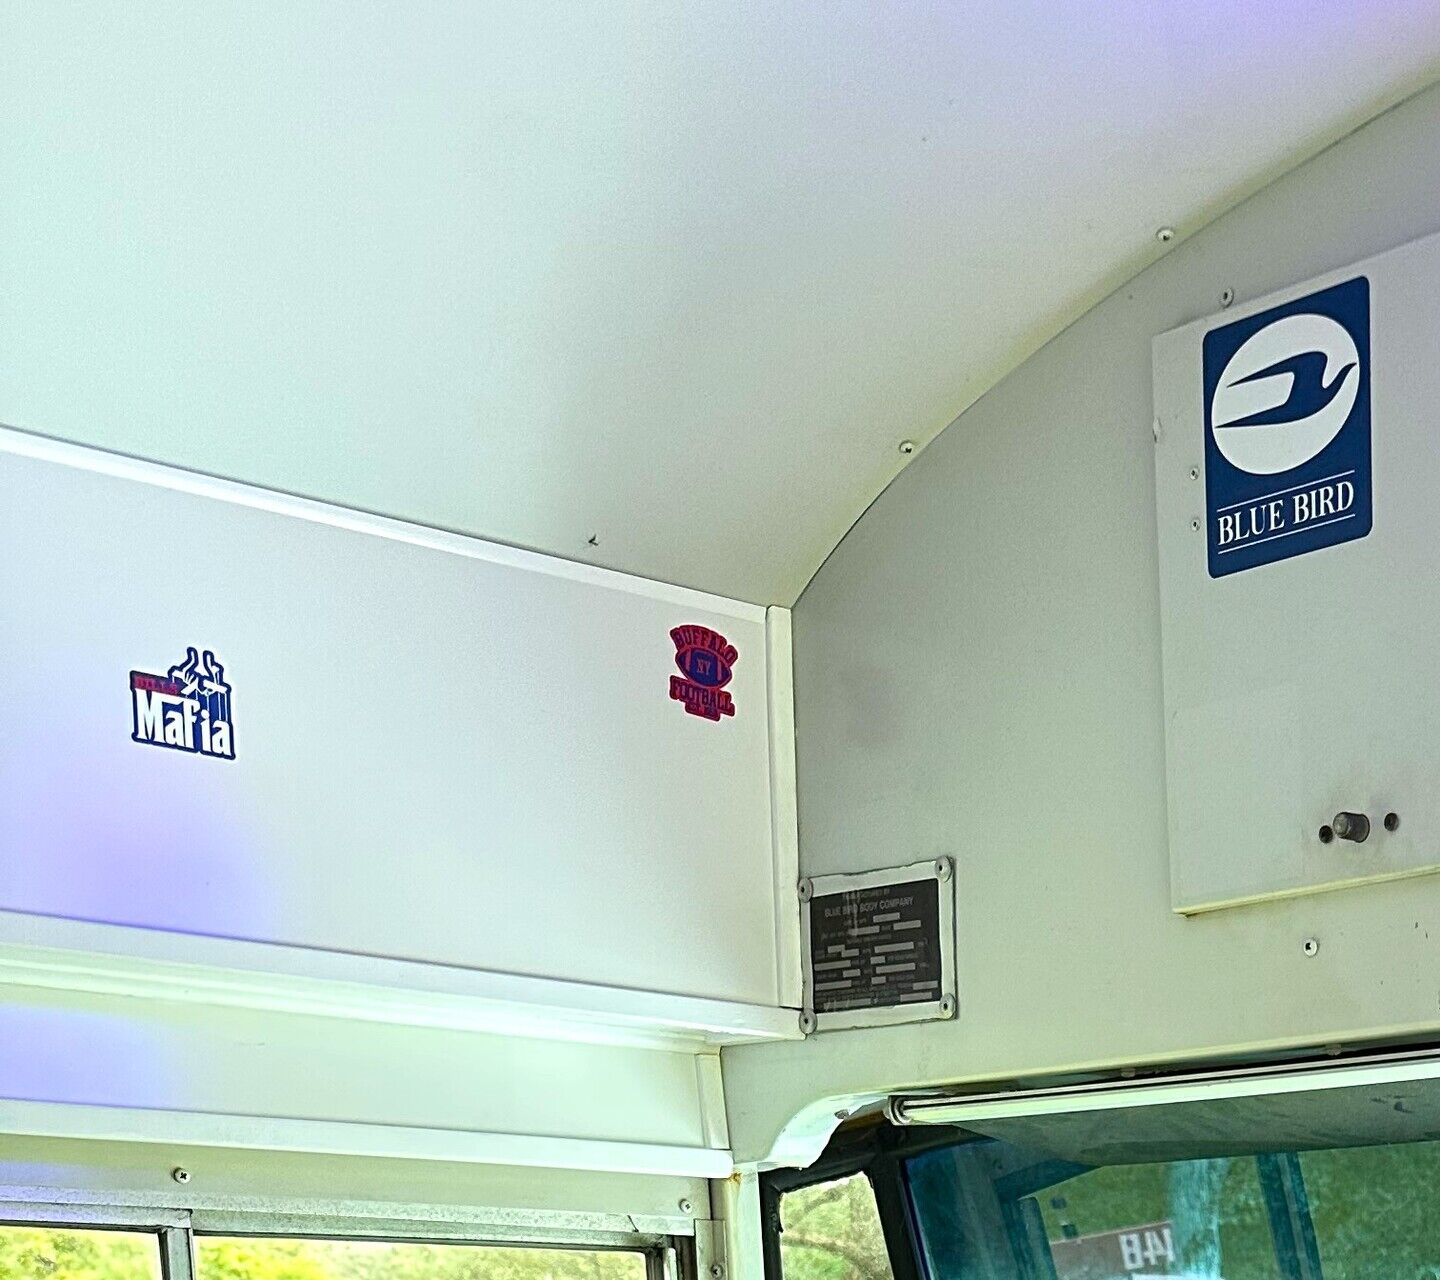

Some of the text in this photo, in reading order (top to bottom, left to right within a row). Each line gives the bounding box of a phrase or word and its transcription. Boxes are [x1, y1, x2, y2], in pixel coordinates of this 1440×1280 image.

[1218, 480, 1355, 545] BLUE BIRD
[672, 627, 738, 667] BUFFALO
[697, 658, 711, 676] NY
[673, 681, 734, 712] FOOTBALL
[135, 688, 232, 756] Mafia
